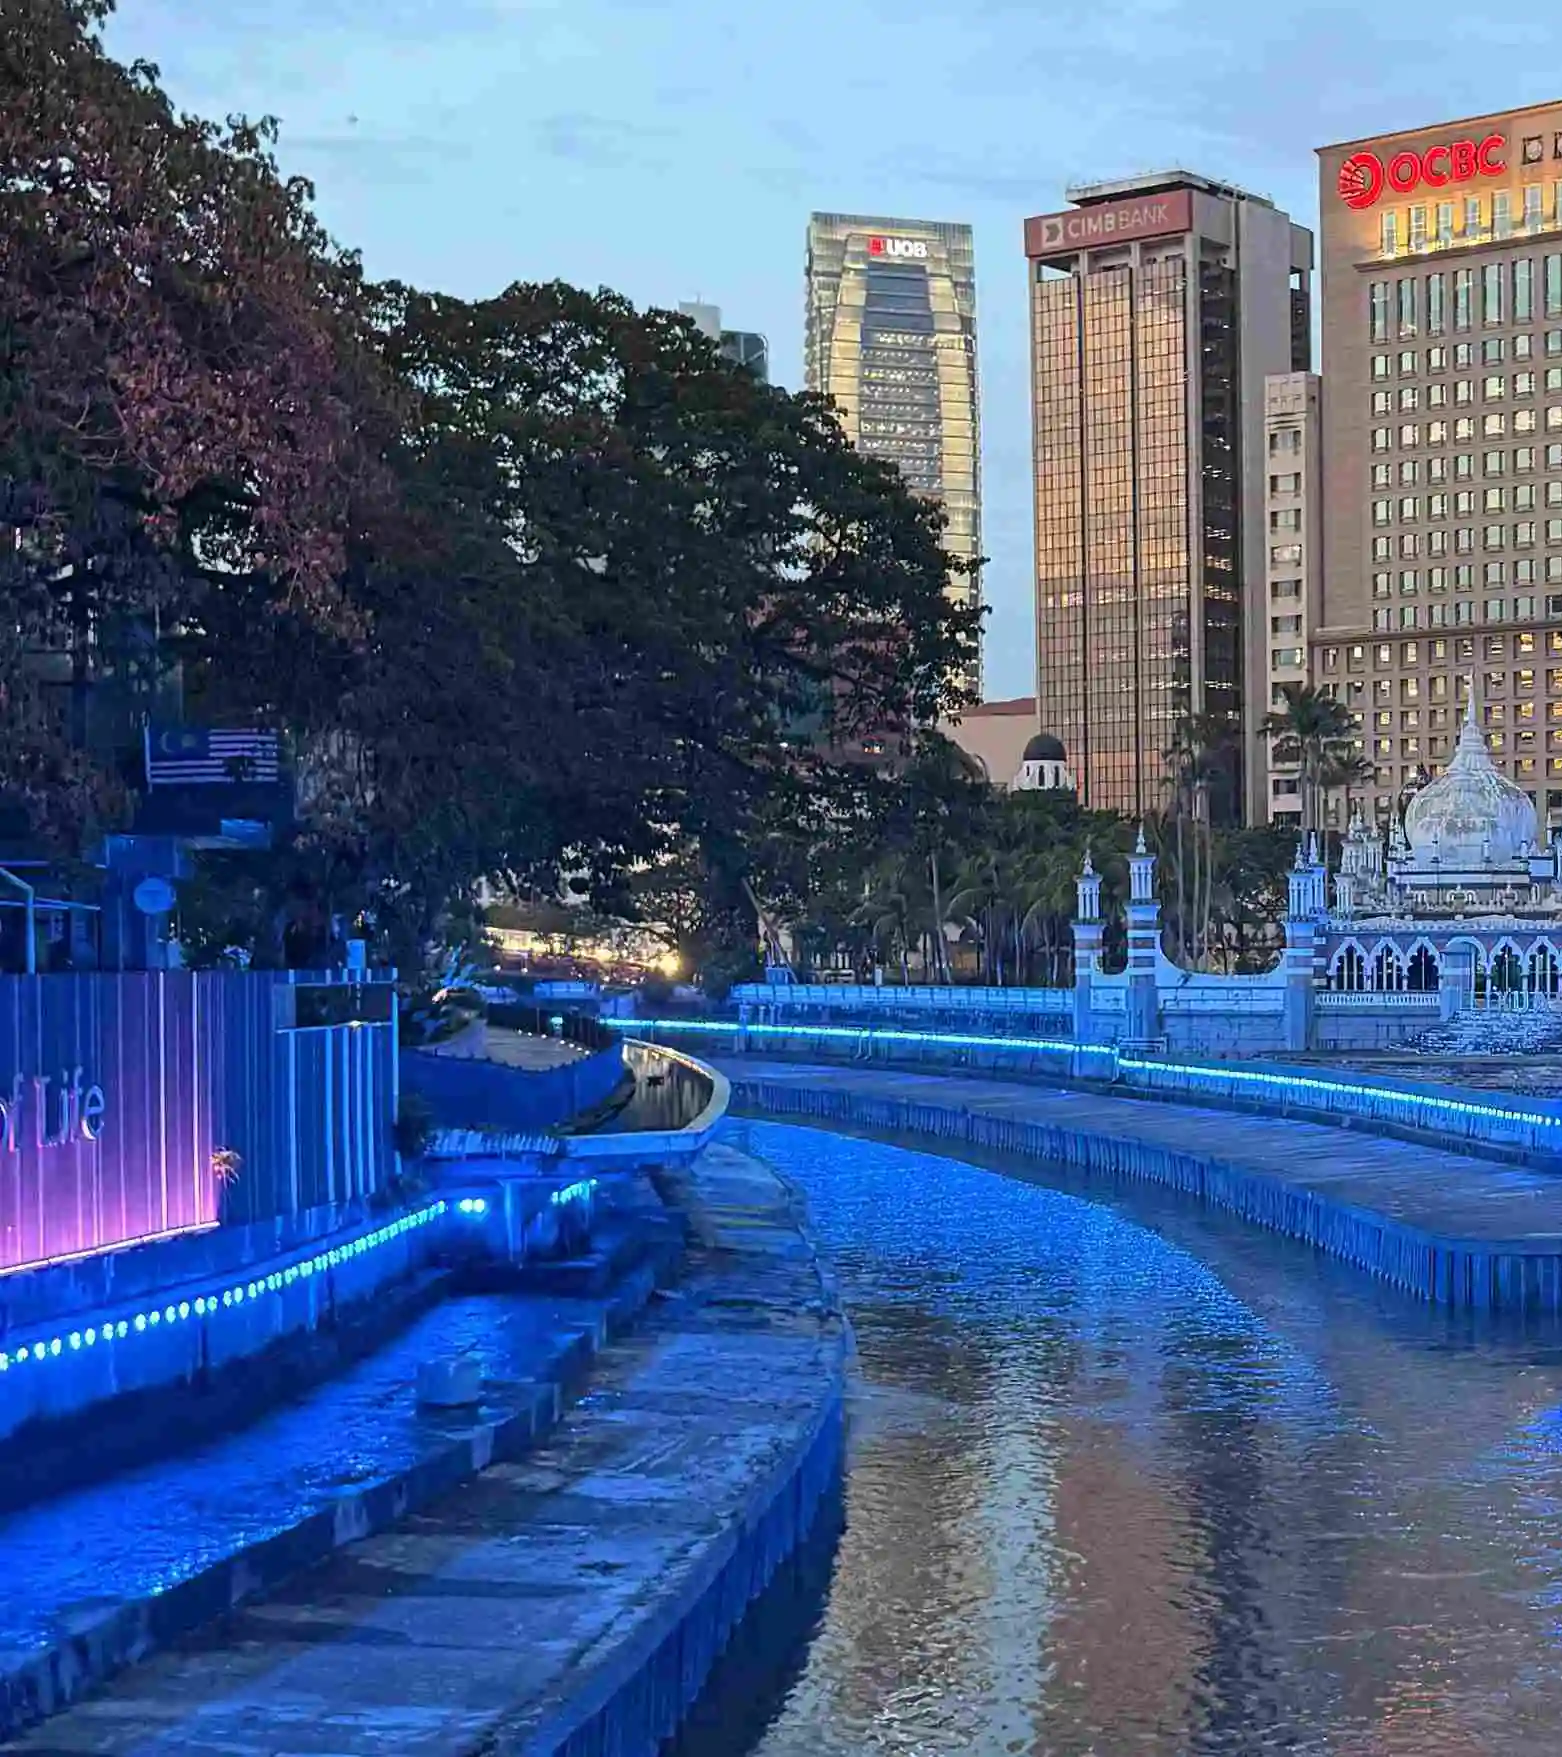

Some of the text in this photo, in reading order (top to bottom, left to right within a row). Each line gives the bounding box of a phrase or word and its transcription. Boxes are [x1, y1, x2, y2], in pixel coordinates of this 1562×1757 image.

[1387, 134, 1507, 194] OCBC
[1067, 203, 1169, 238] CIMB BANK
[886, 238, 928, 258] UOB
[33, 1065, 105, 1149] Life
